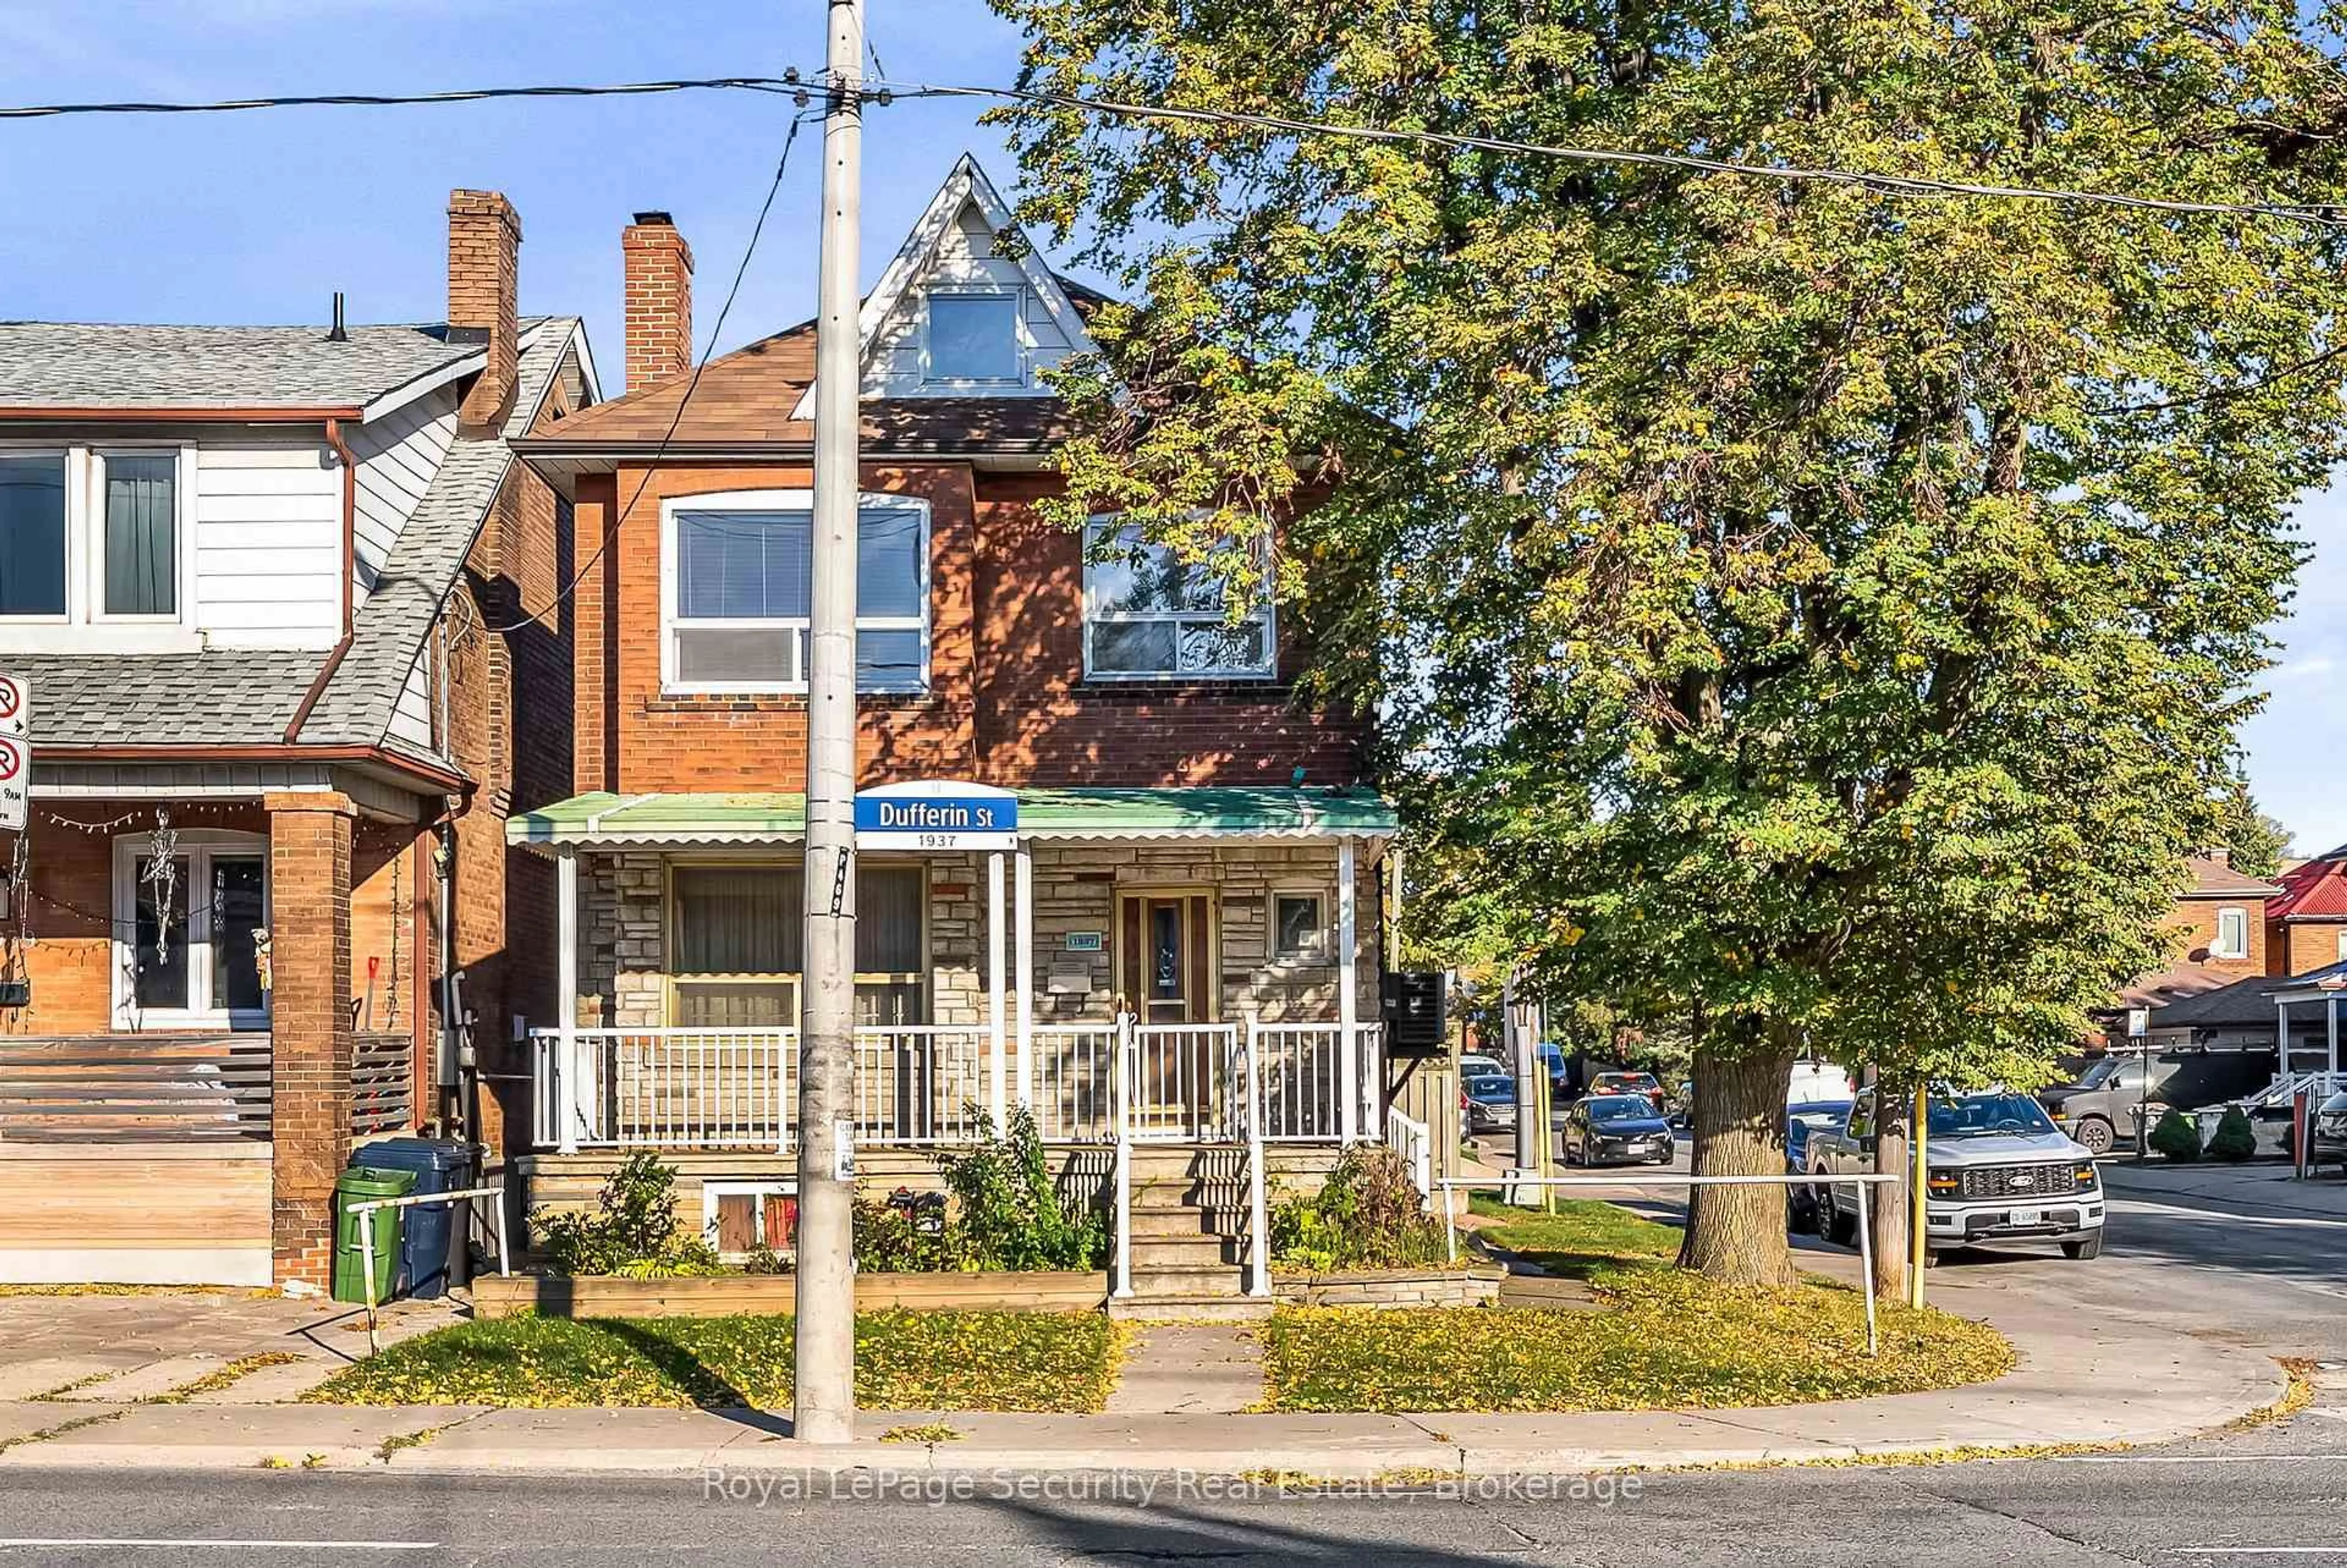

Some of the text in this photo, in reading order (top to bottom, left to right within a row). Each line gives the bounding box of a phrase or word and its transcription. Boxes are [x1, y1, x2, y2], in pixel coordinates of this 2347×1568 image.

[4, 788, 21, 801] 9AM
[880, 802, 994, 827] Dufferin St
[919, 834, 956, 847] 1937
